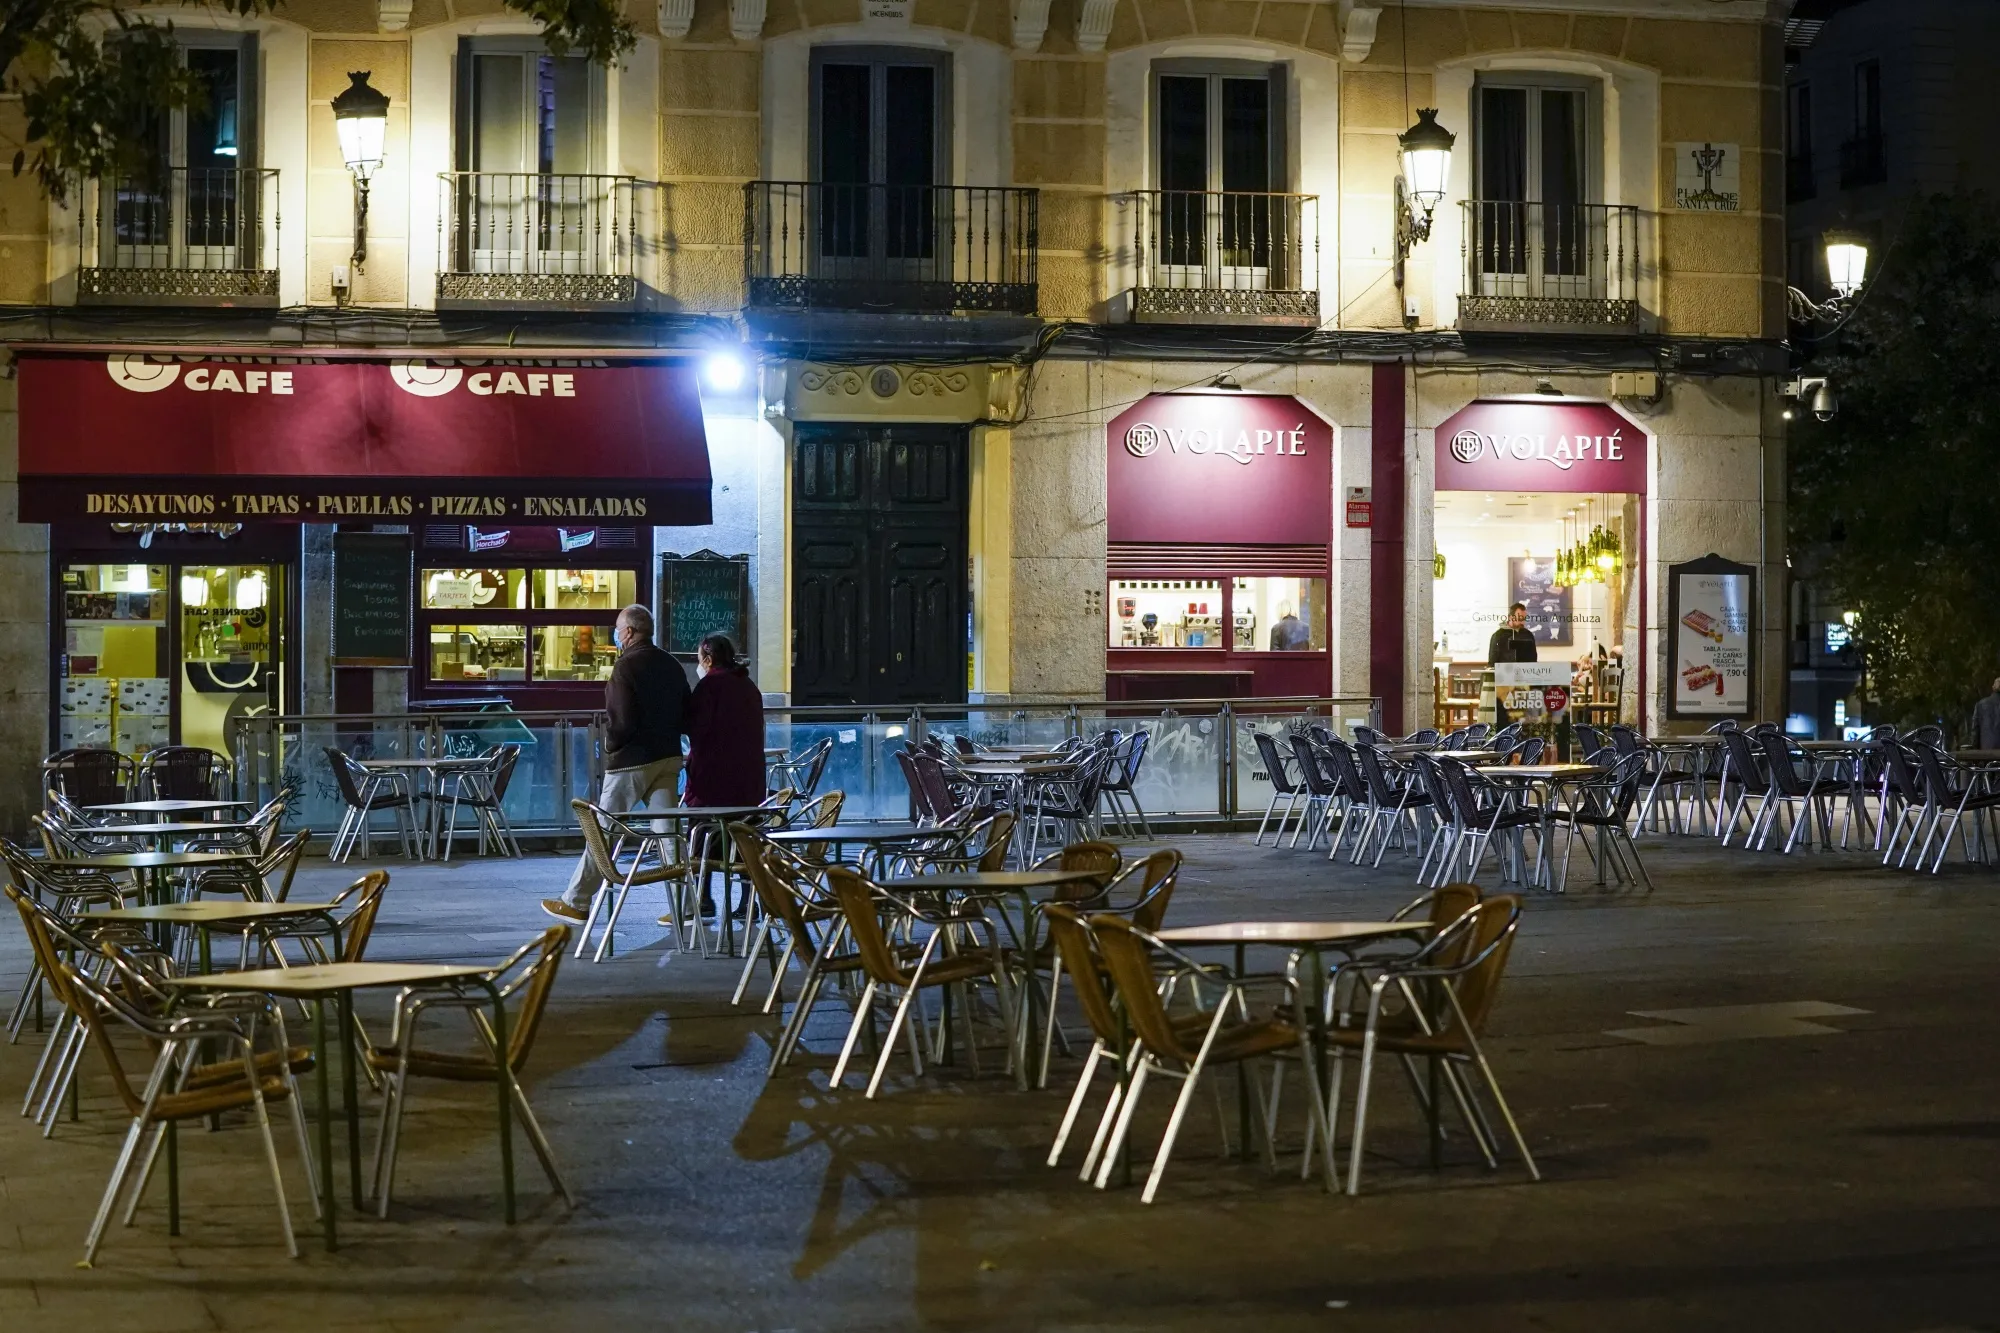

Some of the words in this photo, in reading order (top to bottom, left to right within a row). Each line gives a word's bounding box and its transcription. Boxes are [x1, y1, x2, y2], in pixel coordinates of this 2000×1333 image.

[1677, 199, 1710, 210] SANTA
[1714, 200, 1738, 211] CRUZ
[184, 368, 294, 394] CAFE
[467, 371, 576, 397] CAFE
[879, 371, 890, 392] 6
[1163, 422, 1307, 465] VOLAPIÉ
[1487, 428, 1624, 470] VOLAPIÉ
[86, 493, 215, 515] DESAYUNOS
[232, 494, 300, 515] TAPAS
[317, 495, 413, 516] PAELLAS
[431, 496, 506, 517] PIZZAS
[524, 497, 647, 517] ENSALADAS
[1550, 612, 1601, 623] Andaluza
[1727, 625, 1741, 633] 7,90
[1742, 625, 1747, 633] €
[1726, 669, 1740, 677] 7,90
[1742, 669, 1747, 677] €
[1506, 690, 1544, 700] AFTER
[1503, 699, 1544, 709] CURRO
